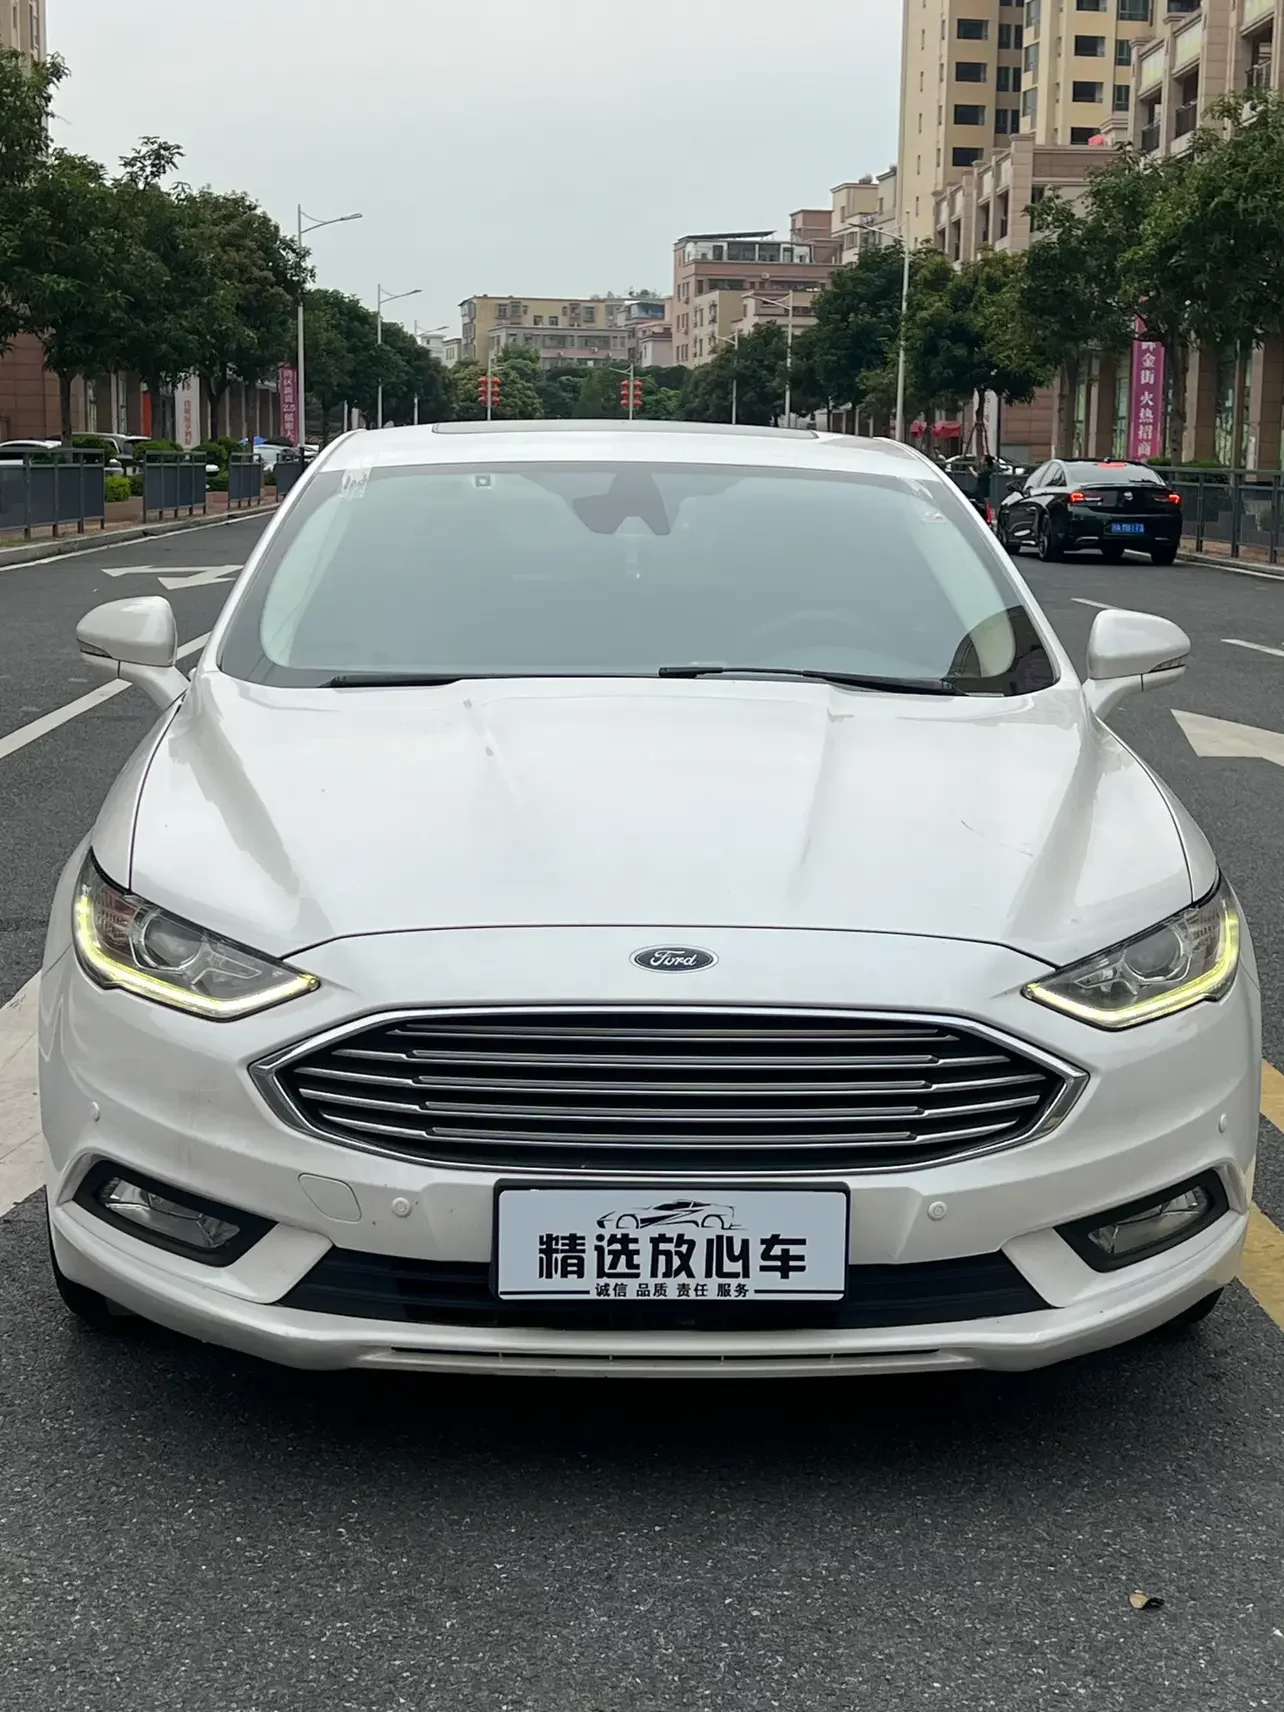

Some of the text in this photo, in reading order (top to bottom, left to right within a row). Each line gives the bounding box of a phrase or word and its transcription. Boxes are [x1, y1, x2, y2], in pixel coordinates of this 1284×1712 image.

[650, 950, 698, 966] Ford
[538, 1232, 807, 1280] 精选放心车
[595, 1282, 750, 1298] 诚信 品质 责任 服务
